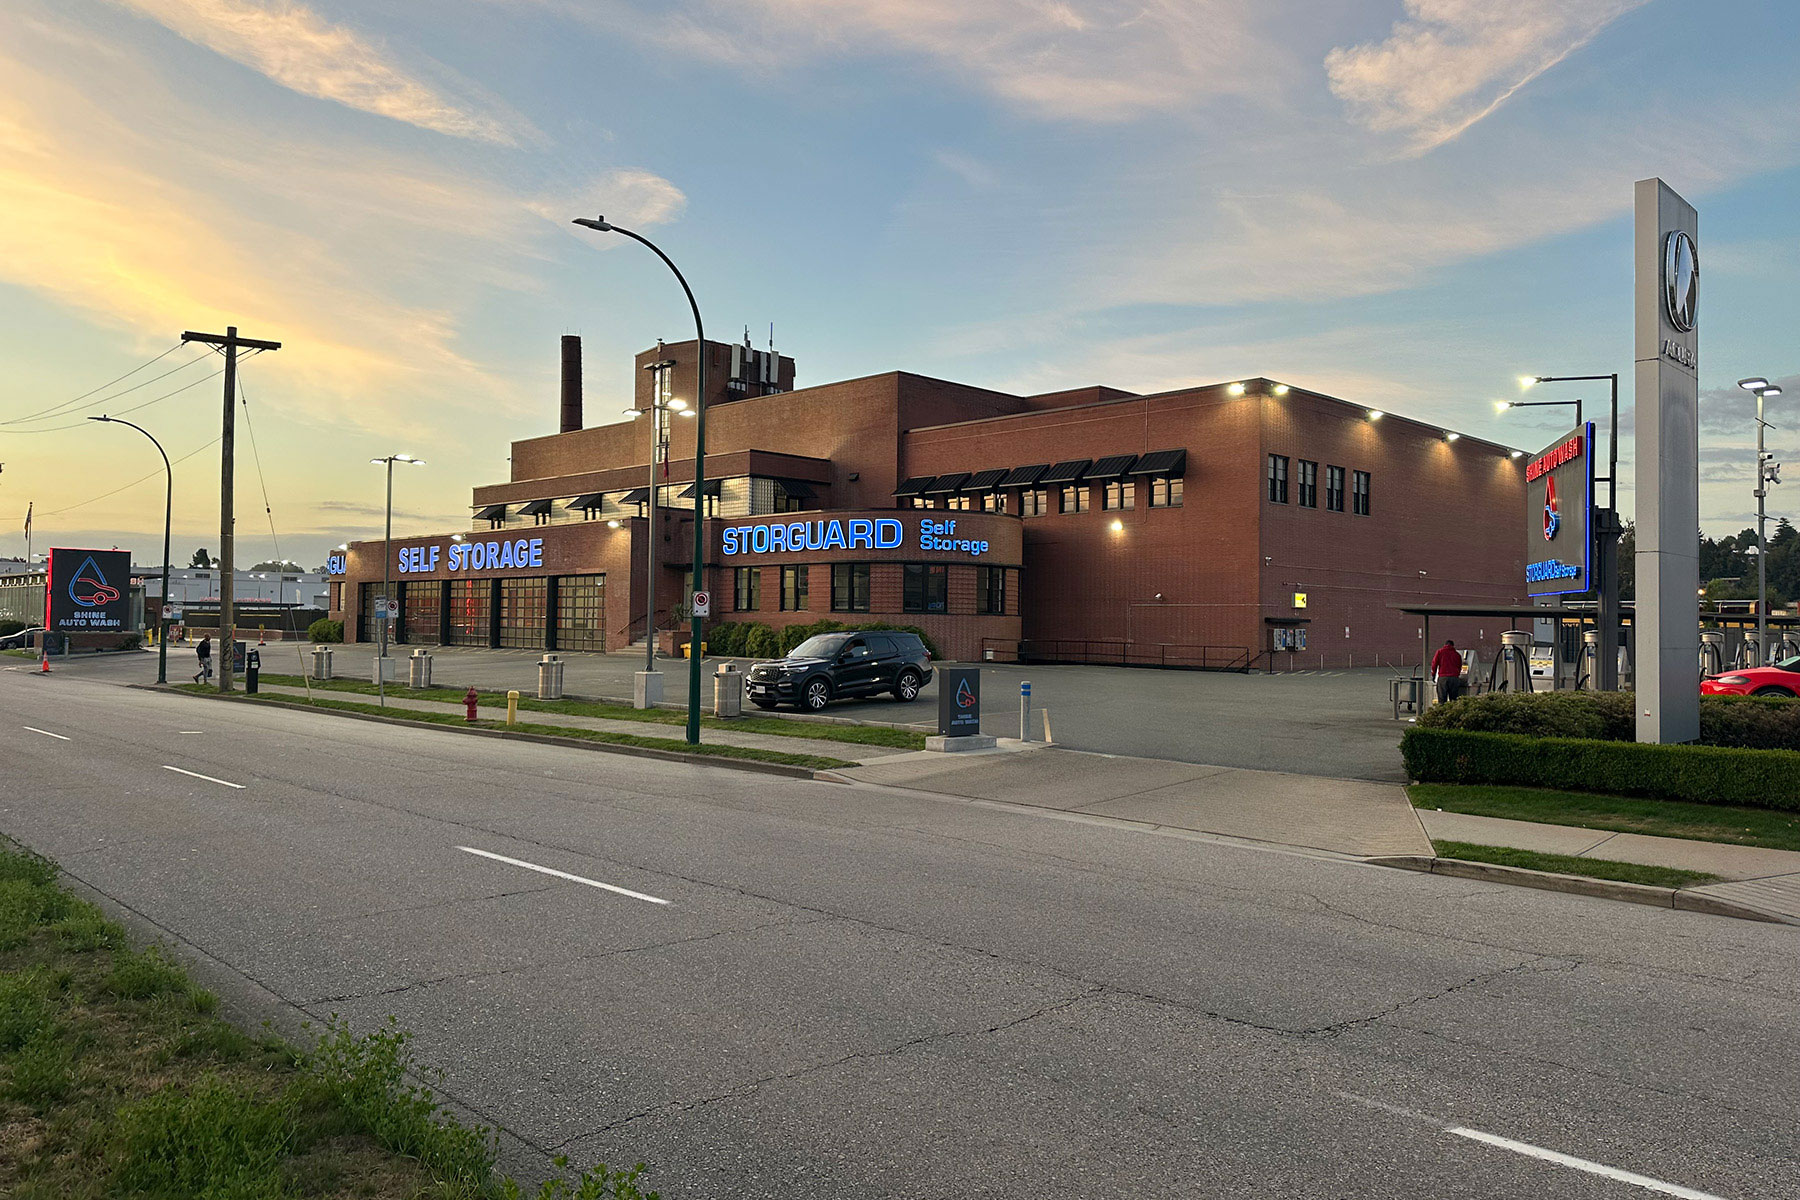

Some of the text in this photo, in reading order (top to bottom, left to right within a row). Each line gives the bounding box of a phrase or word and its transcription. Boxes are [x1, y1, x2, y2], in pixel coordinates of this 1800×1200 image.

[1558, 436, 1579, 465] WASH
[722, 518, 903, 556] STORGUARD
[919, 519, 956, 537] Self
[397, 537, 543, 573] SELF STORAGE
[919, 536, 989, 556] Storage
[58, 619, 121, 627] AUTO WASH
[73, 611, 107, 619] SHINE
